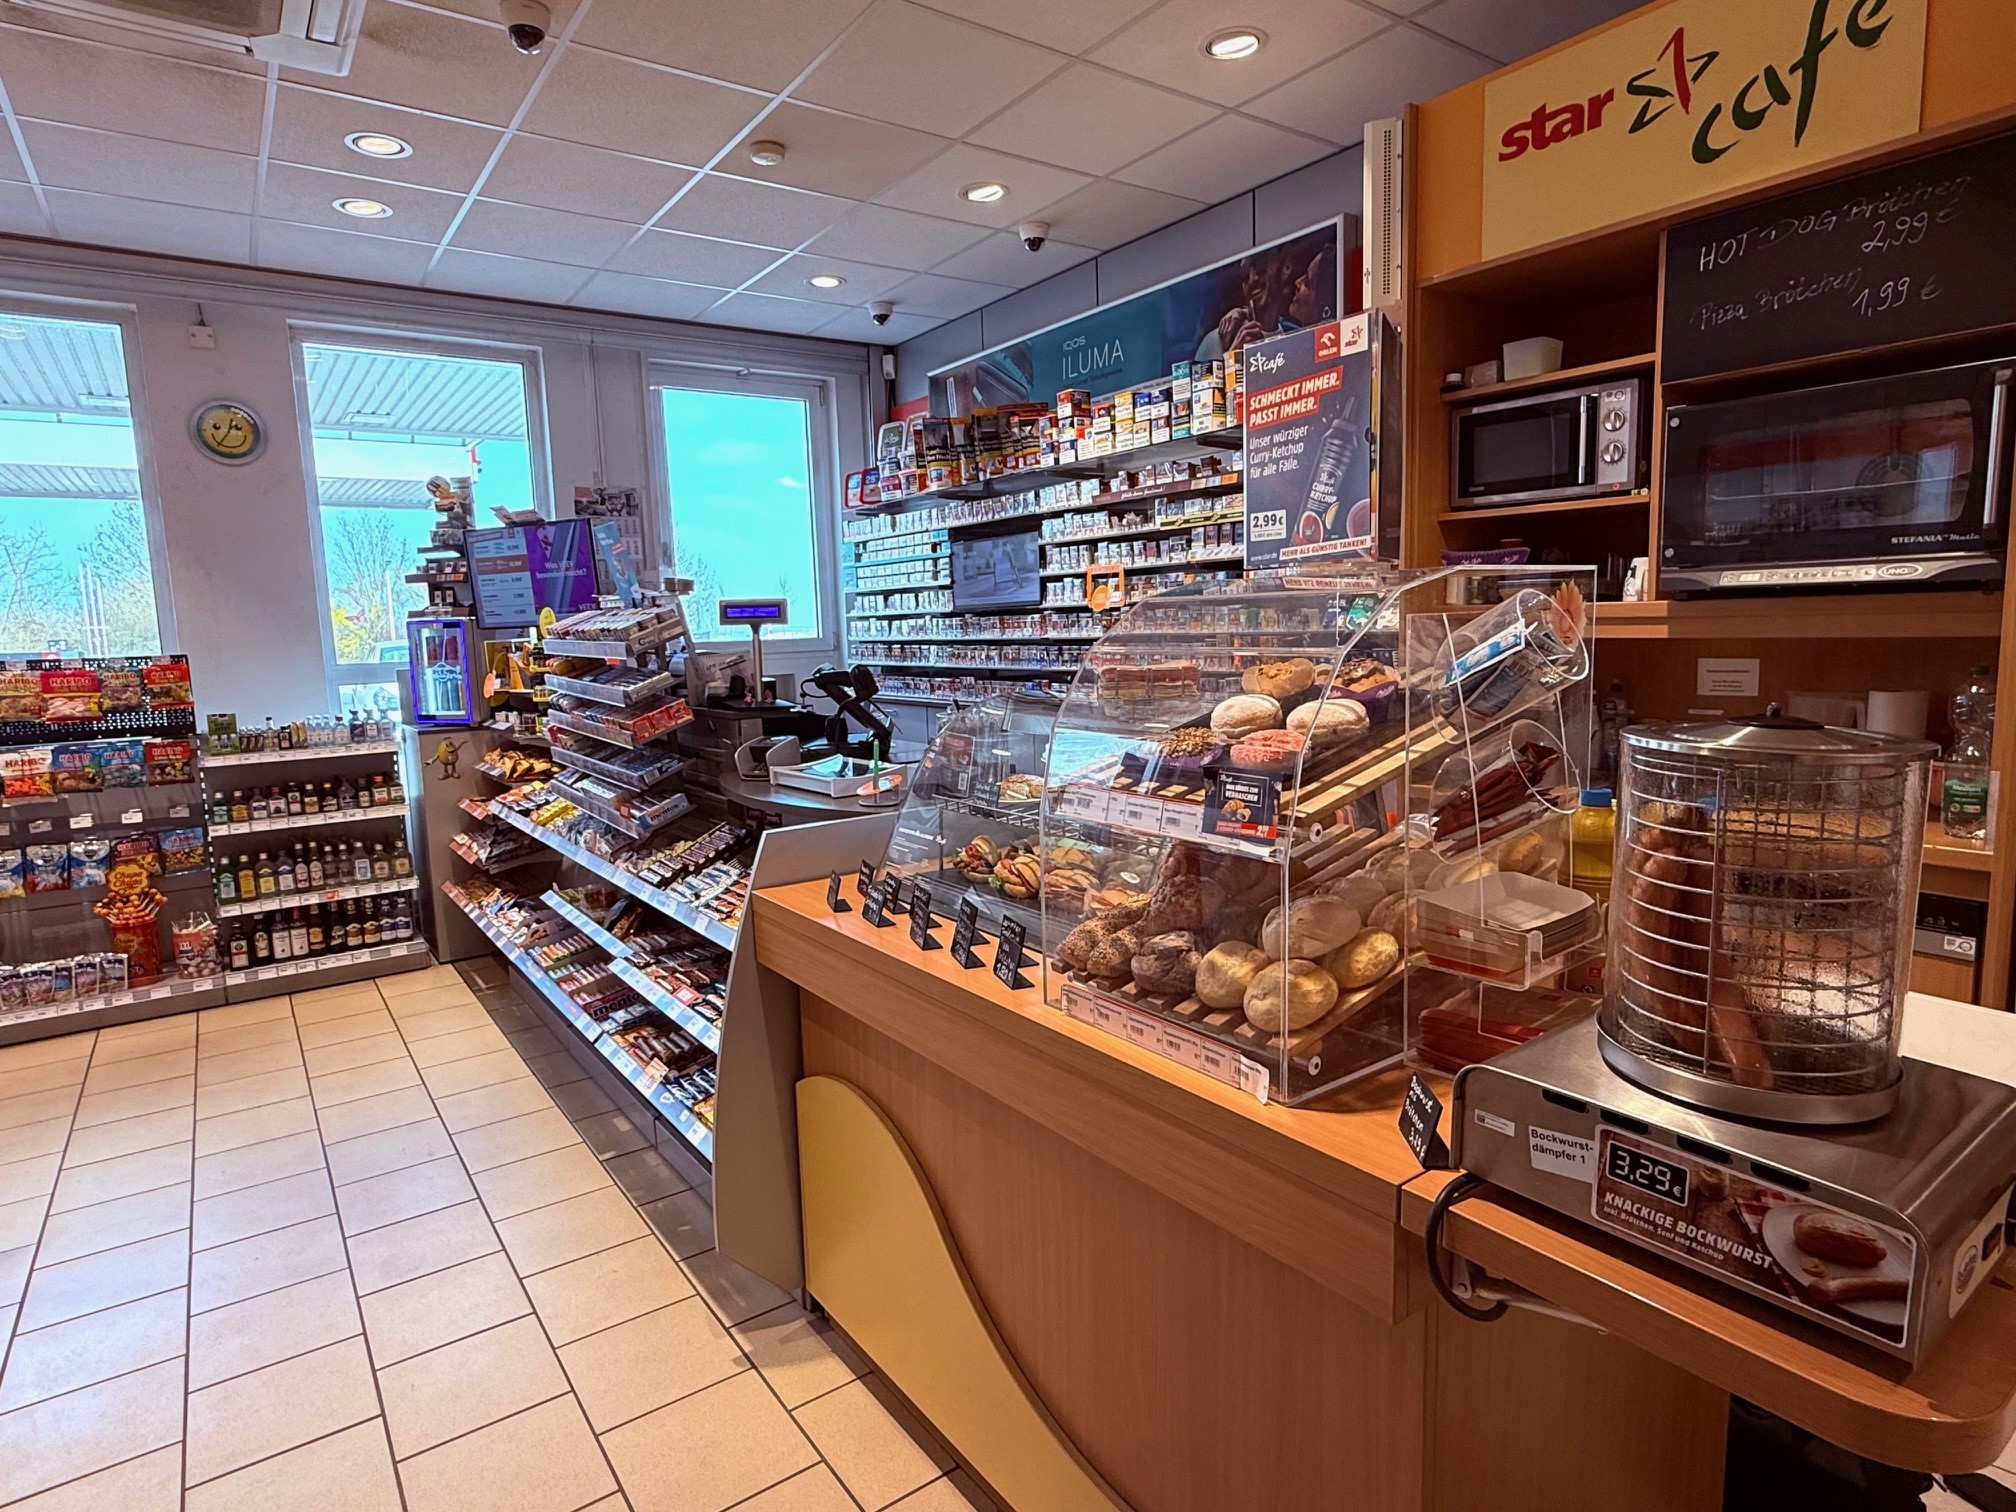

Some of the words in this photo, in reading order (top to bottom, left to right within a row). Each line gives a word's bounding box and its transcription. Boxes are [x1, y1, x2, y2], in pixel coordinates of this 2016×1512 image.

[1499, 88, 1614, 162] star
[1861, 212, 1929, 253] 2,99
[1852, 277, 1911, 317] 1,99
[1920, 276, 1945, 301] €
[1690, 302, 1748, 331] Pizza
[1063, 335, 1086, 351] IQOS
[1318, 347, 1338, 357] ORLEN
[1063, 339, 1124, 380] ILUMA
[1263, 352, 1285, 374] café
[1249, 383, 1301, 411] SCHMECKT
[1301, 372, 1340, 394] IMMER.
[1249, 406, 1280, 428] PASST
[1280, 396, 1317, 418] IMMER.
[1250, 435, 1271, 450] Unser
[1273, 426, 1308, 443] würziger
[1250, 442, 1304, 465] Curry-Ketchup
[1250, 466, 1261, 479] für
[1263, 463, 1277, 476] alle
[1279, 457, 1299, 473] Fälle.
[1282, 549, 1298, 557] MEHR
[1300, 546, 1310, 555] ALS
[1311, 542, 1338, 553] GÜNSTIG
[1339, 538, 1367, 549] TANKEN!
[1891, 534, 1942, 544] STEFANIA
[0, 677, 38, 686] HARIBO
[50, 676, 91, 686] HARIBO
[103, 671, 136, 680] HARIBO
[59, 752, 92, 763] HARIBO
[651, 804, 678, 821] mentos
[114, 871, 143, 881] Chupa
[114, 879, 143, 890] Chups
[593, 993, 640, 1017] mento
[1531, 1129, 1594, 1152] Bockwurst-
[1532, 1143, 1577, 1161] dämpfer
[1580, 1155, 1586, 1164] 1
[1604, 1192, 1675, 1230] KNACKIGE
[1676, 1220, 1774, 1269] BOCKWURST
[1620, 1212, 1656, 1233] Brötchen,
[1657, 1228, 1675, 1240] Senf
[1675, 1235, 1691, 1247] und
[1691, 1241, 1725, 1260] Ketchup
